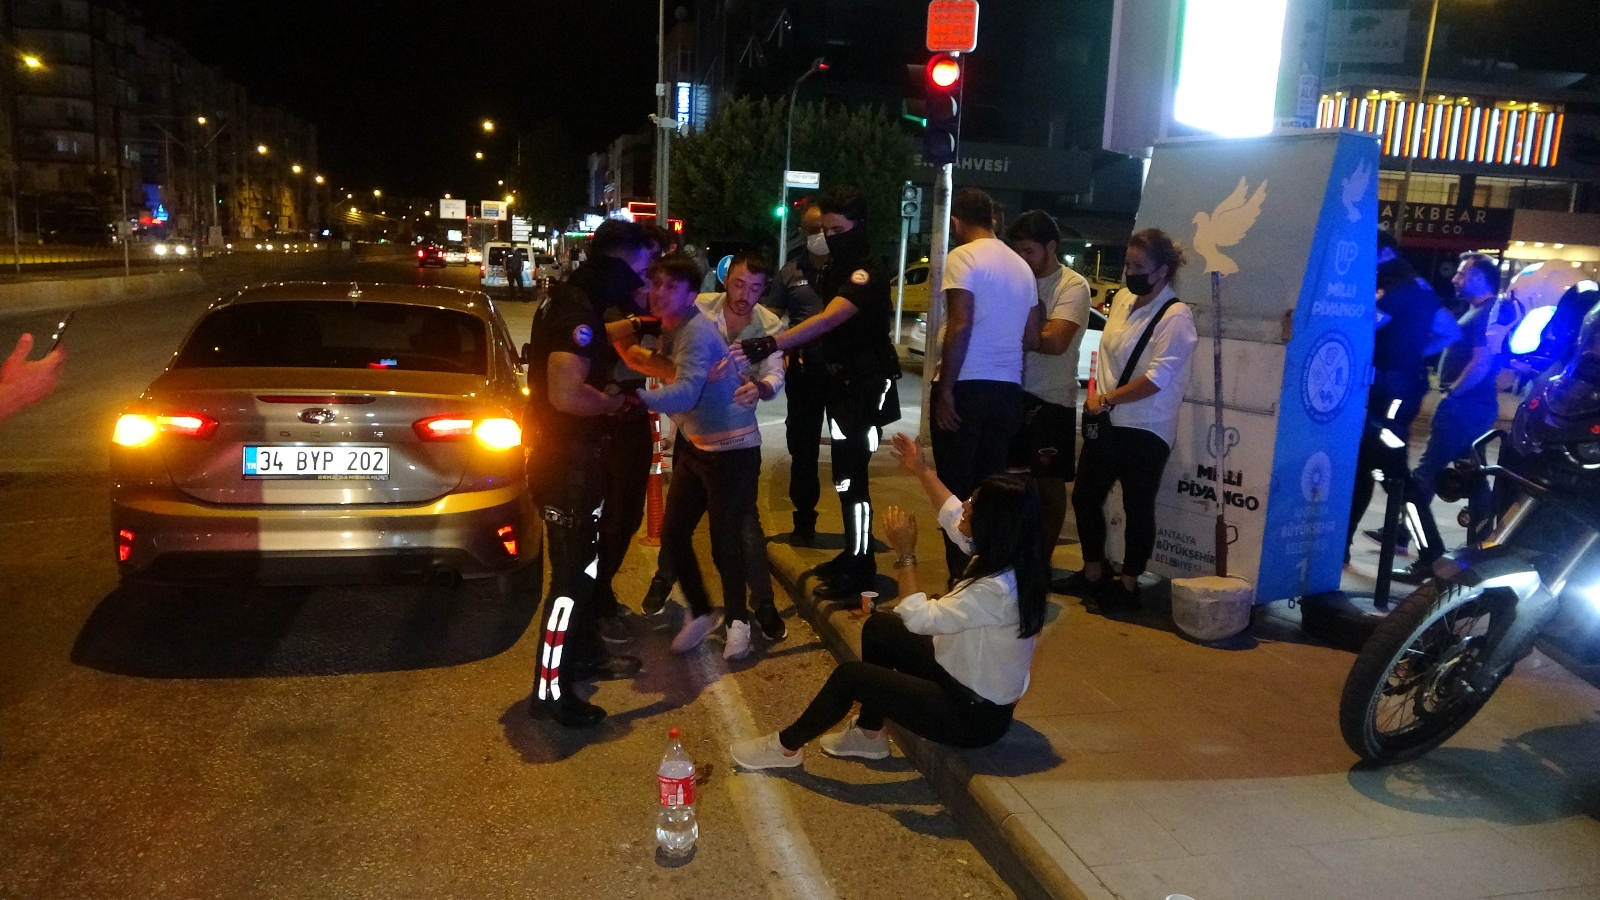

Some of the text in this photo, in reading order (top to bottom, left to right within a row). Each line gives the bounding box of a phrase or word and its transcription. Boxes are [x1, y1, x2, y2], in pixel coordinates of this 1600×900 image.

[1381, 204, 1487, 224] ACKBEAR
[260, 451, 284, 471] 34
[296, 451, 334, 471] BYP
[347, 451, 383, 471] 202
[1177, 480, 1260, 511] PİYANGO
[1157, 528, 1197, 546] ANTALYA
[1156, 539, 1217, 565] BÜYÜKŞEHİR
